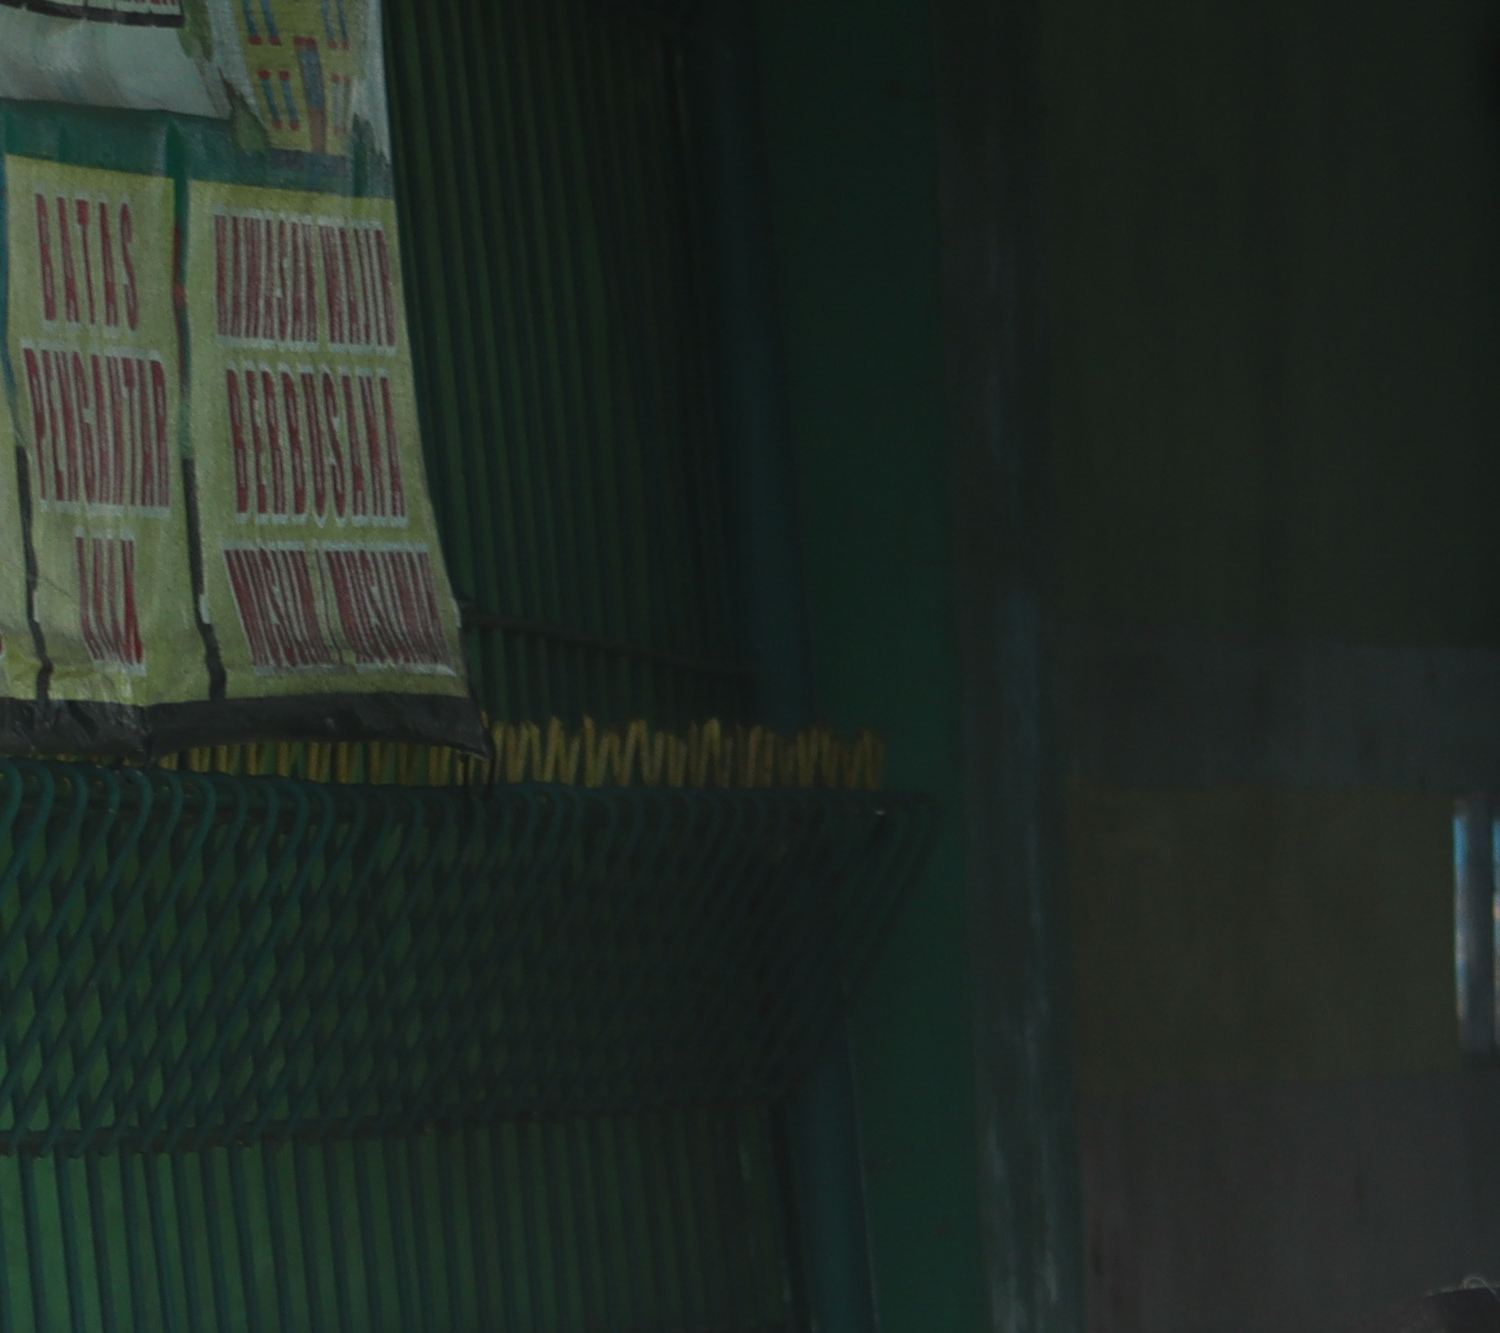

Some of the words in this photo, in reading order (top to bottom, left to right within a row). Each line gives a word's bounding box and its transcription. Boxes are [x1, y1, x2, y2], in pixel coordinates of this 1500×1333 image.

[35, 190, 139, 333] BATAS
[214, 213, 318, 345] KAWASAN
[319, 223, 396, 349] WAJIB
[23, 345, 170, 511] PENGANTAR
[226, 367, 408, 520] BERBUSANA
[224, 547, 332, 670] MUSLIM
[325, 548, 452, 667] MUSLIMAH
